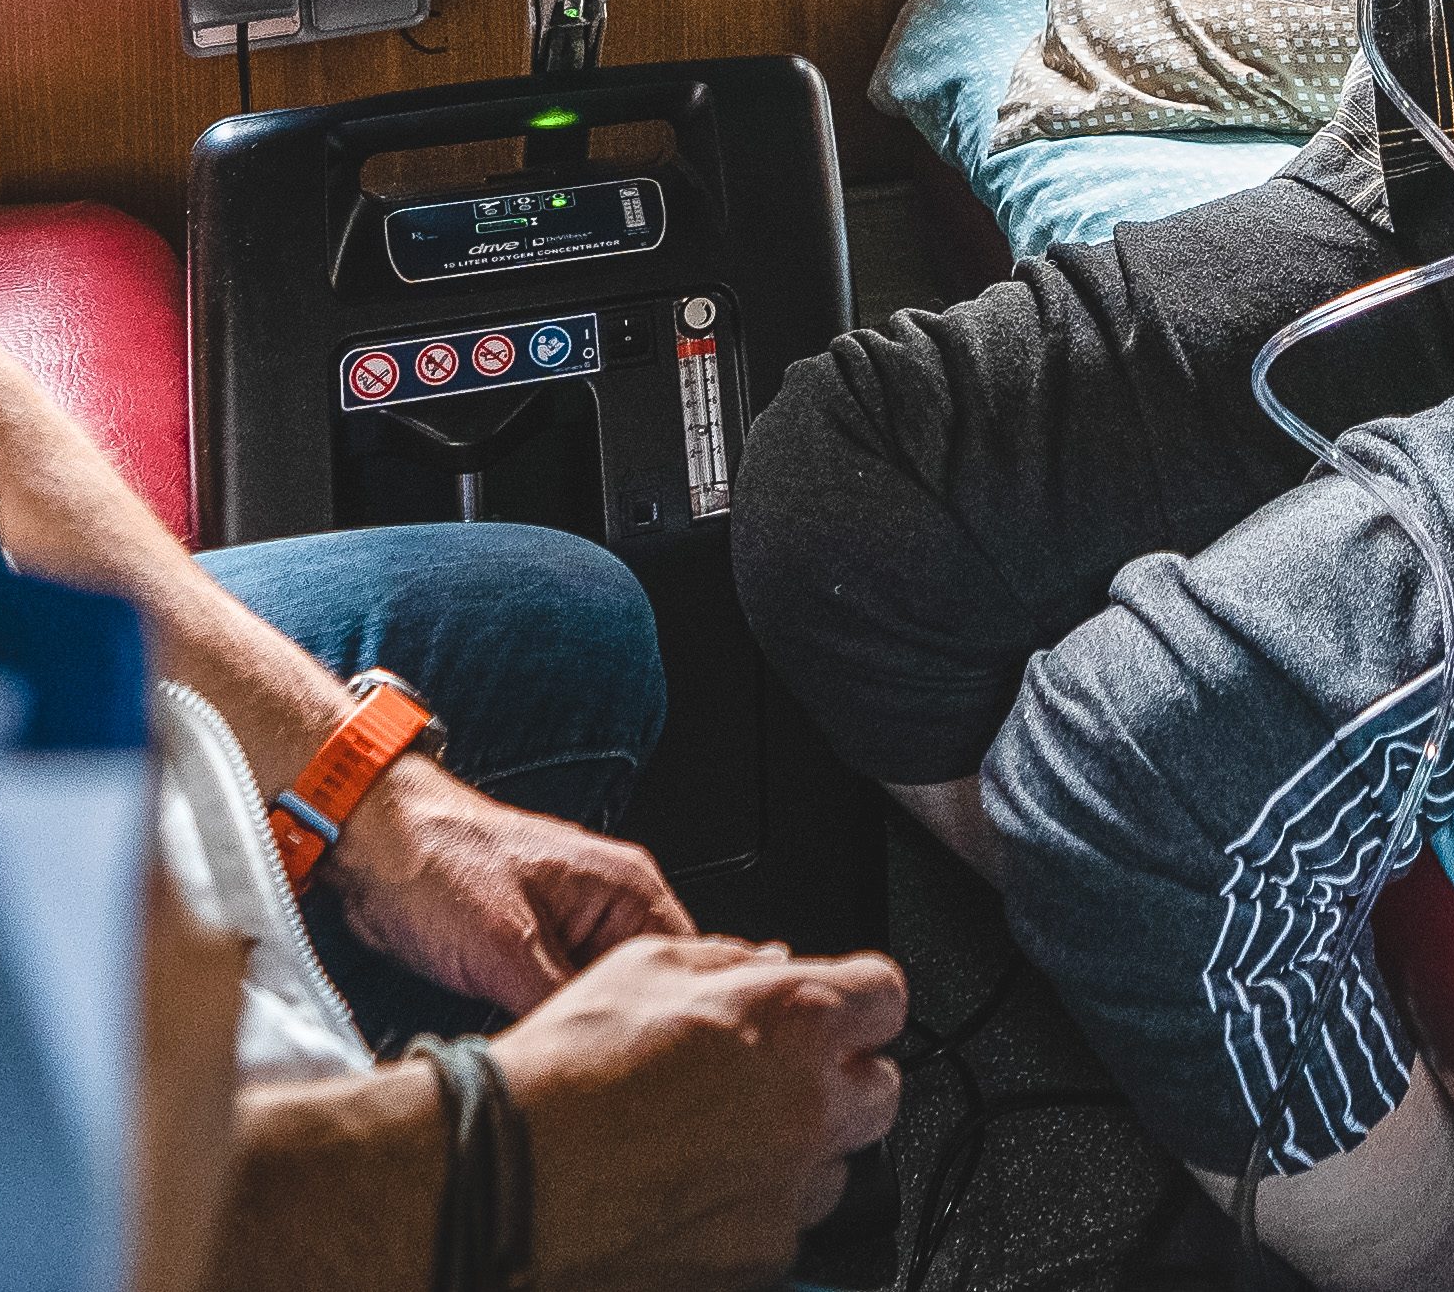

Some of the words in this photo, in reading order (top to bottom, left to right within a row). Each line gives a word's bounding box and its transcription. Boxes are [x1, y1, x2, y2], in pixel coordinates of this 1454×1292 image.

[458, 257, 488, 267] LITER
[491, 251, 534, 263] OXYGEN
[537, 239, 620, 257] CONCENTRATOR
[468, 241, 520, 255] drive
